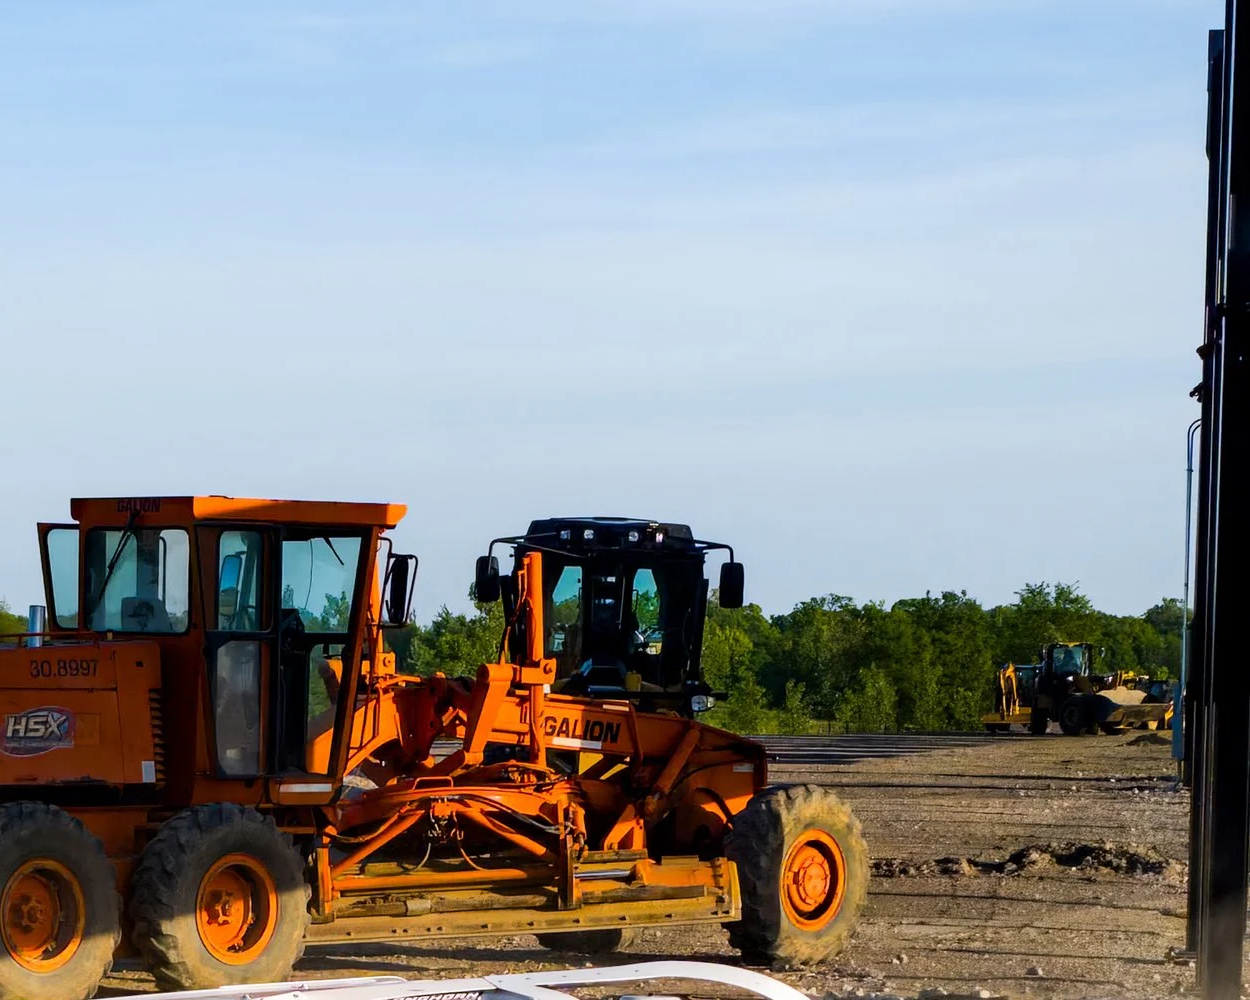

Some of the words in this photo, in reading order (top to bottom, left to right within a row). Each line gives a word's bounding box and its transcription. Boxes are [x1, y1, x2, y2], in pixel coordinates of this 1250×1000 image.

[29, 659, 99, 679] 30.8997
[5, 712, 69, 739] HSX
[544, 716, 622, 744] GALION
